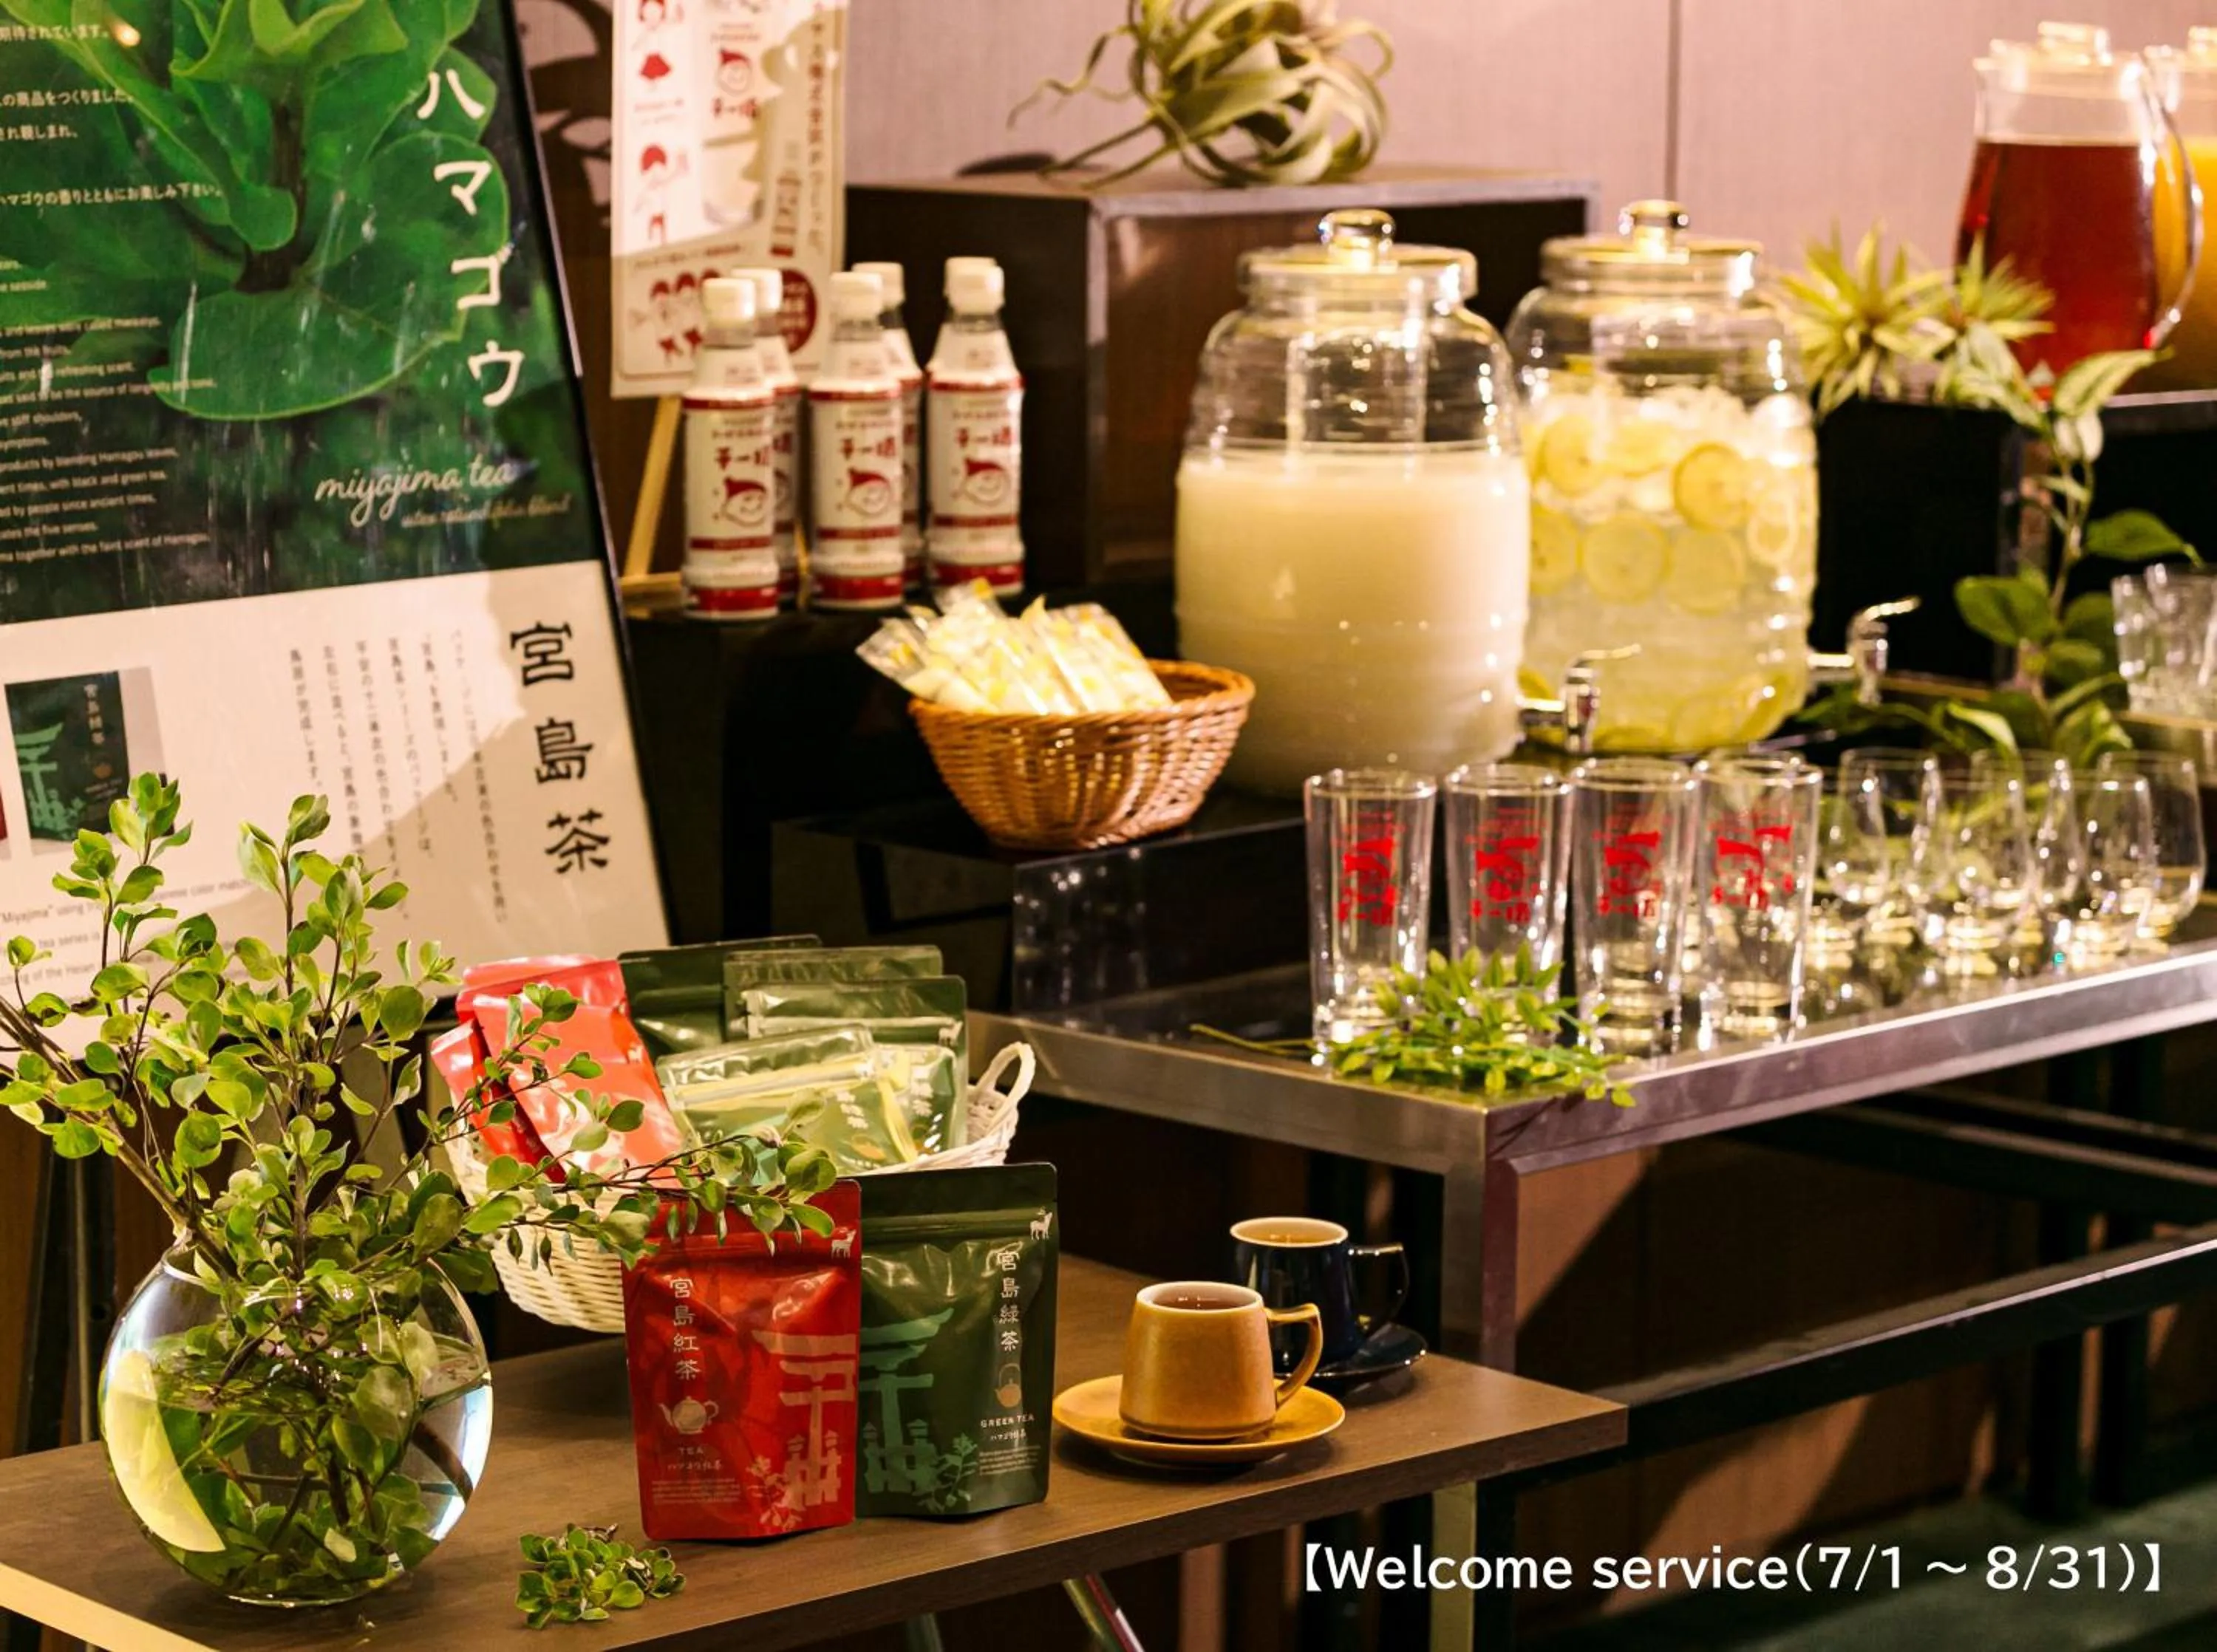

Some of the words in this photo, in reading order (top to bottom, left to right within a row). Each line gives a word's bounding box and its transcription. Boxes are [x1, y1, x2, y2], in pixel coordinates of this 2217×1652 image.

[0, 88, 134, 107] の商品をつくりました。
[417, 69, 526, 409] ハマゴウ
[314, 463, 463, 528] miyajima
[469, 453, 517, 488] tea
[509, 621, 611, 876] 宮島茶
[669, 1277, 702, 1382] 宮島紅茶
[996, 1249, 1022, 1353] 宮島緑茶
[677, 1446, 704, 1455] TEA
